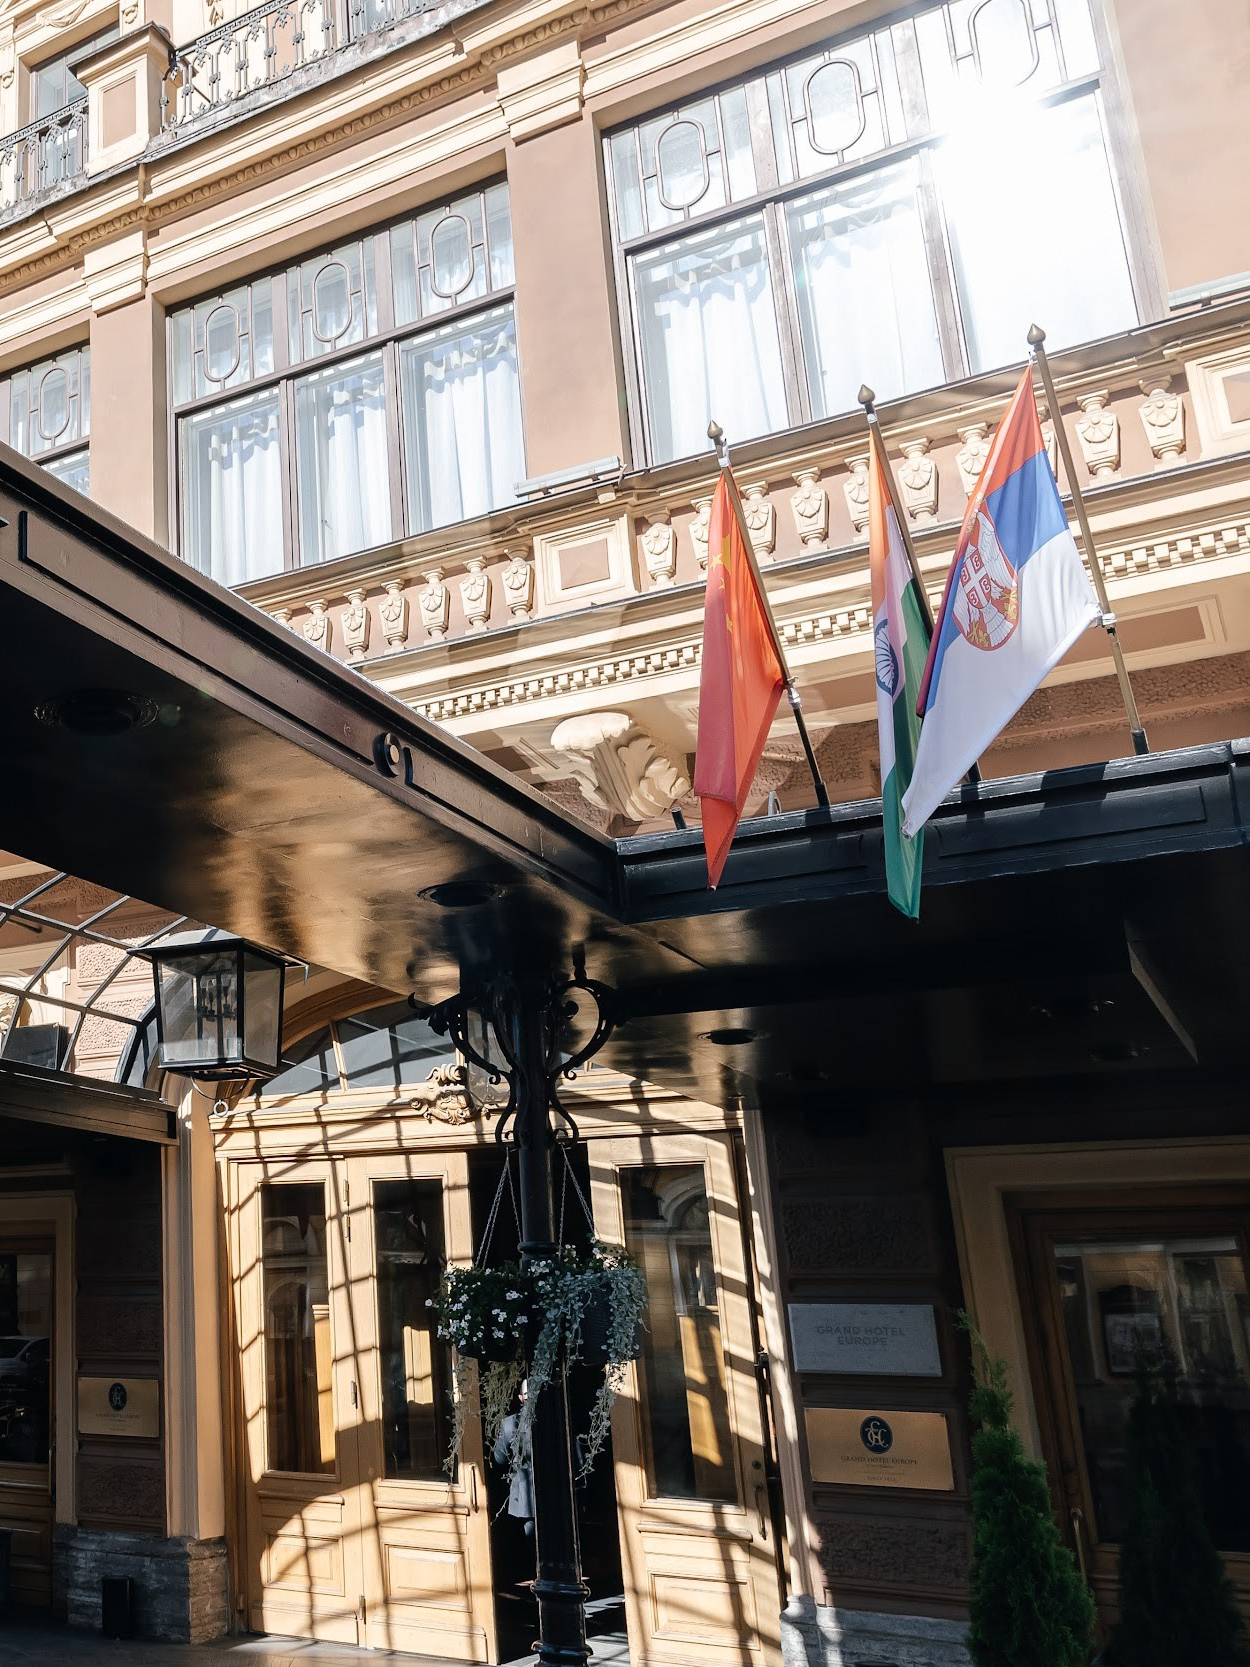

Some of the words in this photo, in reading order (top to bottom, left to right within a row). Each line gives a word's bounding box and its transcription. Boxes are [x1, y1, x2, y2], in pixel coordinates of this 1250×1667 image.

[816, 1325, 861, 1335] GRAND
[864, 1326, 906, 1336] HOTEL
[837, 1336, 888, 1346] EUROPE
